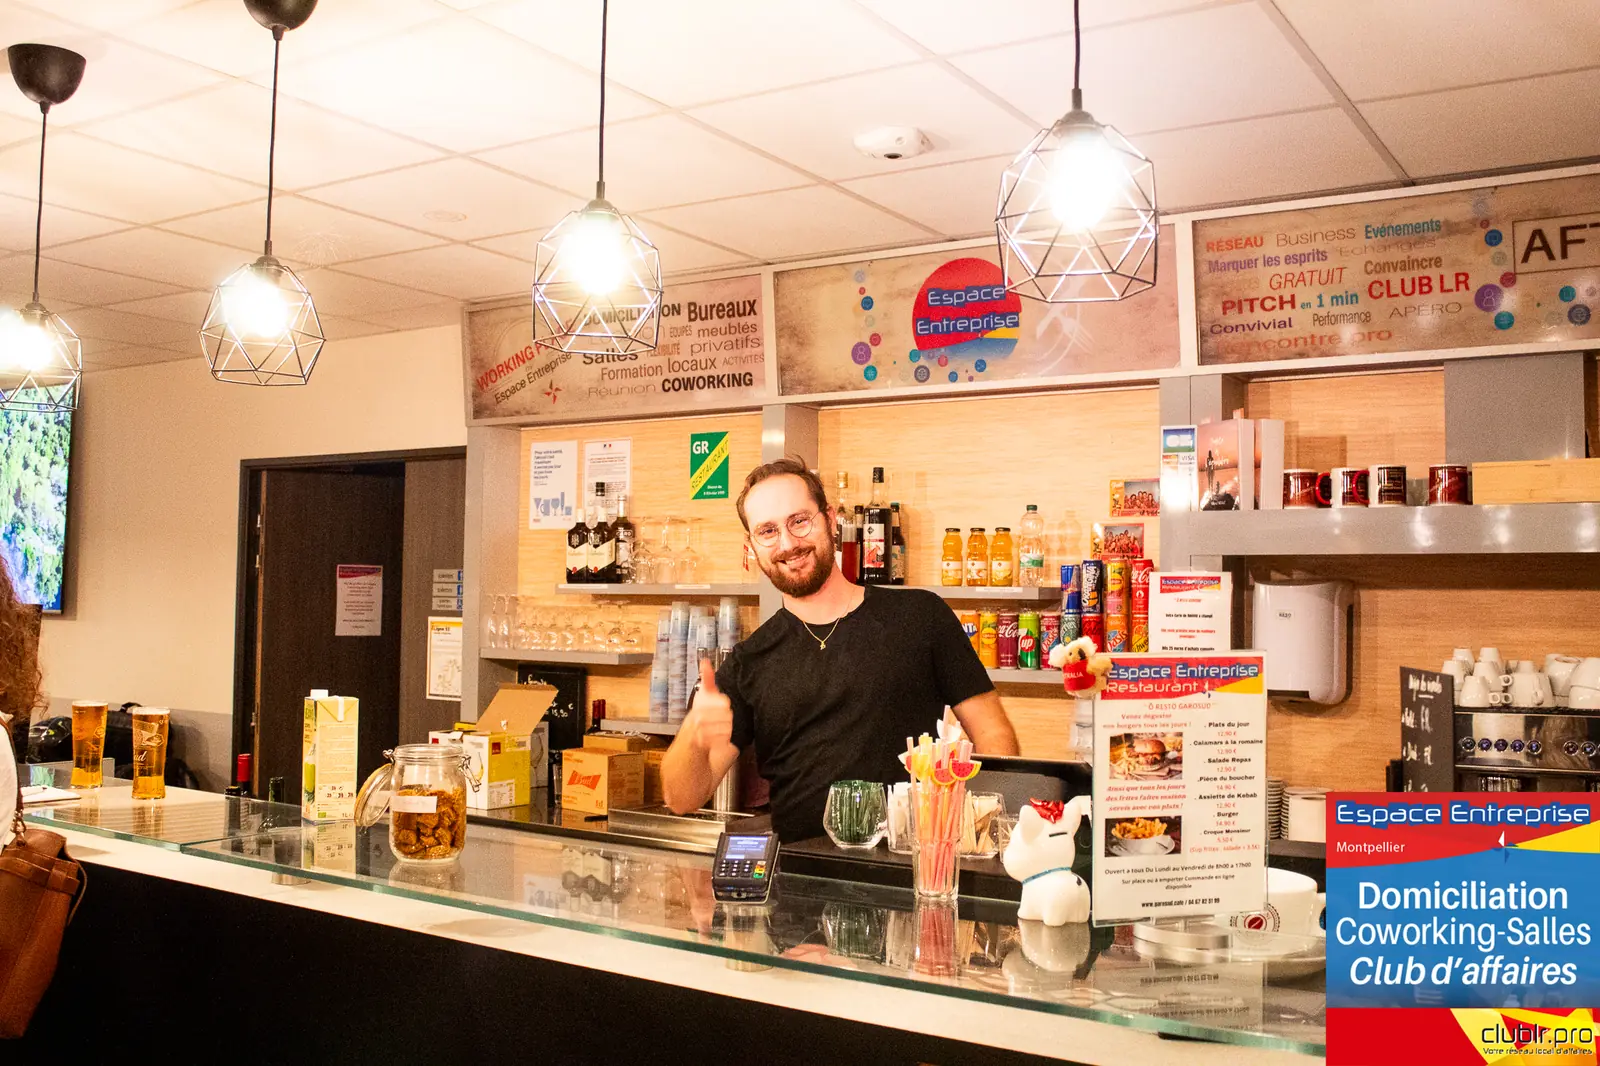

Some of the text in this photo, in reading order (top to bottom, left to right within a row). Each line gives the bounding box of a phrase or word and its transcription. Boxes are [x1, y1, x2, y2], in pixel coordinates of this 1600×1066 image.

[1276, 226, 1356, 248] Business
[1208, 249, 1328, 273] Marquer les esprits
[1364, 255, 1443, 275] Convaincre
[1268, 266, 1348, 291] GRATUIT
[1367, 271, 1471, 300] CLUB LR
[928, 285, 1005, 306] Espace
[1221, 290, 1359, 316] PITCH en 1 min
[687, 298, 758, 322] Bureaux
[1312, 310, 1372, 327] Performance
[697, 321, 758, 338] meublés
[917, 312, 1020, 335] Entreprise
[1210, 317, 1294, 335] Convivial
[690, 335, 761, 357] privatifs
[476, 345, 535, 391] WORKING
[495, 351, 572, 404] Espace Entreprise
[601, 364, 663, 381] Formation
[668, 357, 717, 373] locaux
[588, 372, 753, 398] Réunion COWORKING
[692, 440, 709, 454] GR
[1107, 630, 1128, 652] Oasis
[1107, 662, 1259, 681] Espace Entreprise
[1106, 680, 1198, 693] Restaurant
